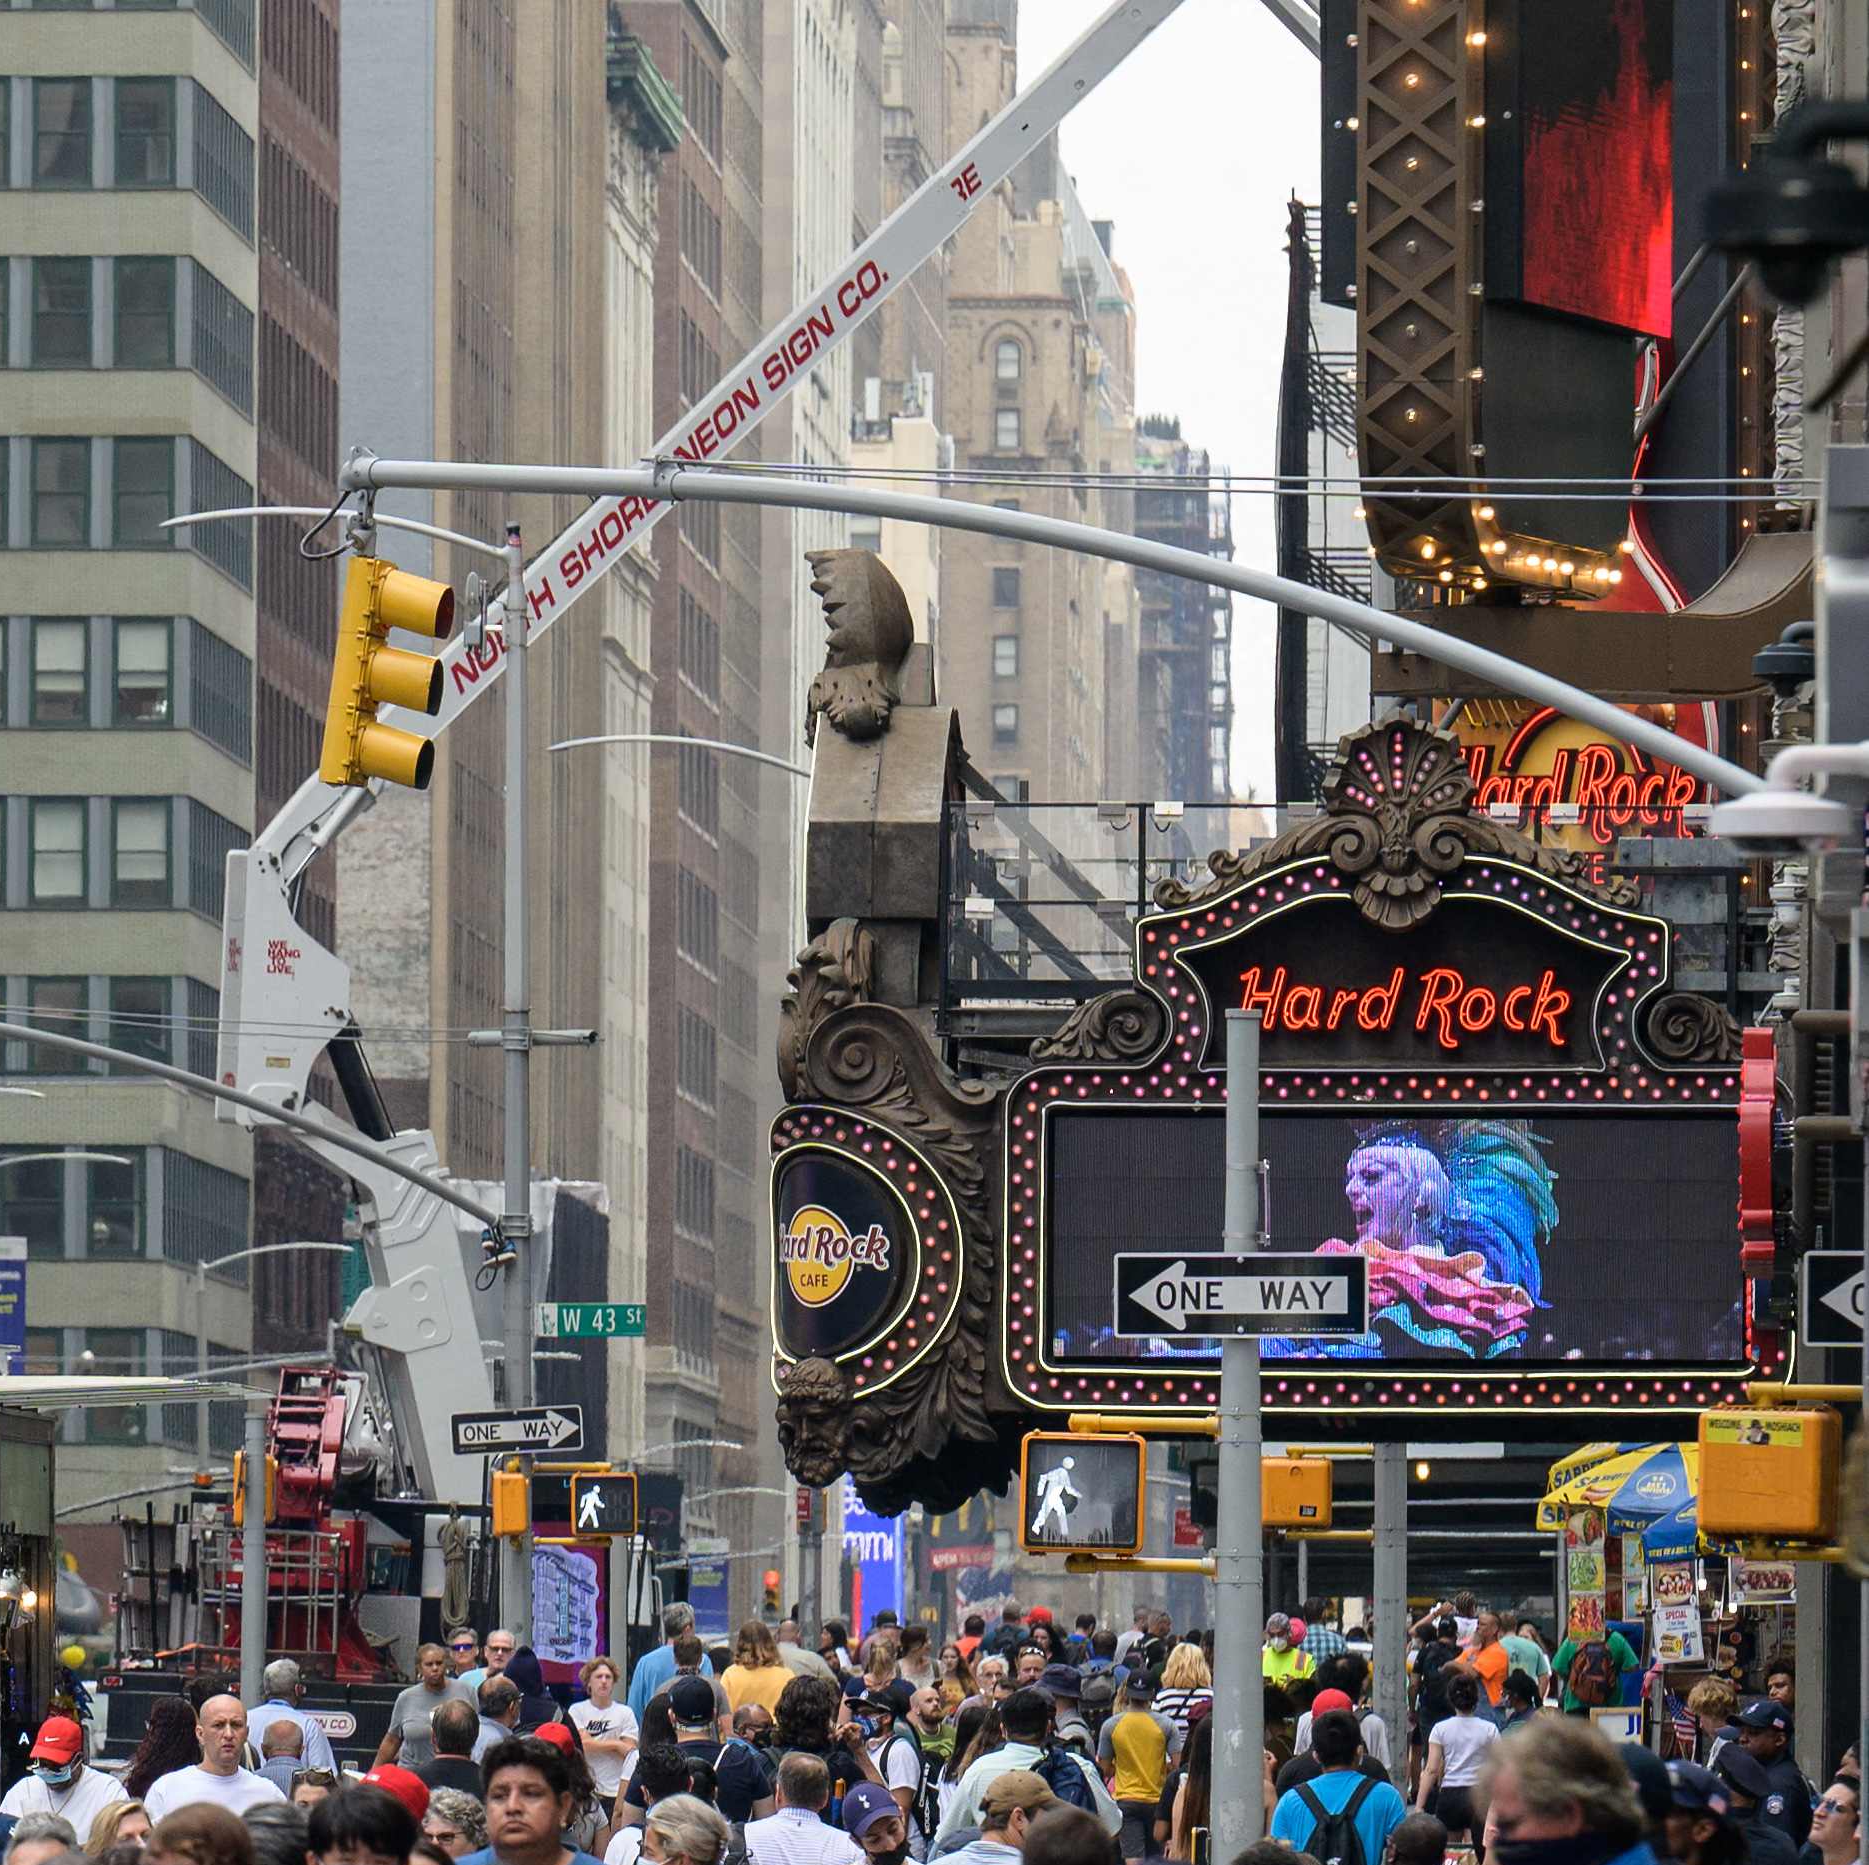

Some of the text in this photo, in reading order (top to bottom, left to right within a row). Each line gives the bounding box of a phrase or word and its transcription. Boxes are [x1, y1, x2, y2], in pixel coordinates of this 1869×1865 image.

[450, 577, 555, 694] NOTH
[673, 378, 761, 466] NEON
[762, 305, 835, 391] SIGN
[838, 261, 889, 318] CO.
[1578, 744, 1696, 845] Rock
[1238, 966, 1572, 1050] Hard Rock
[815, 1224, 889, 1270] Rock
[800, 1274, 828, 1287] CAFE
[1156, 1281, 1333, 1310] ONE WAY
[563, 1307, 642, 1330] W 43 St
[464, 1420, 563, 1441] ONE WAY
[18, 1733, 30, 1746] A
